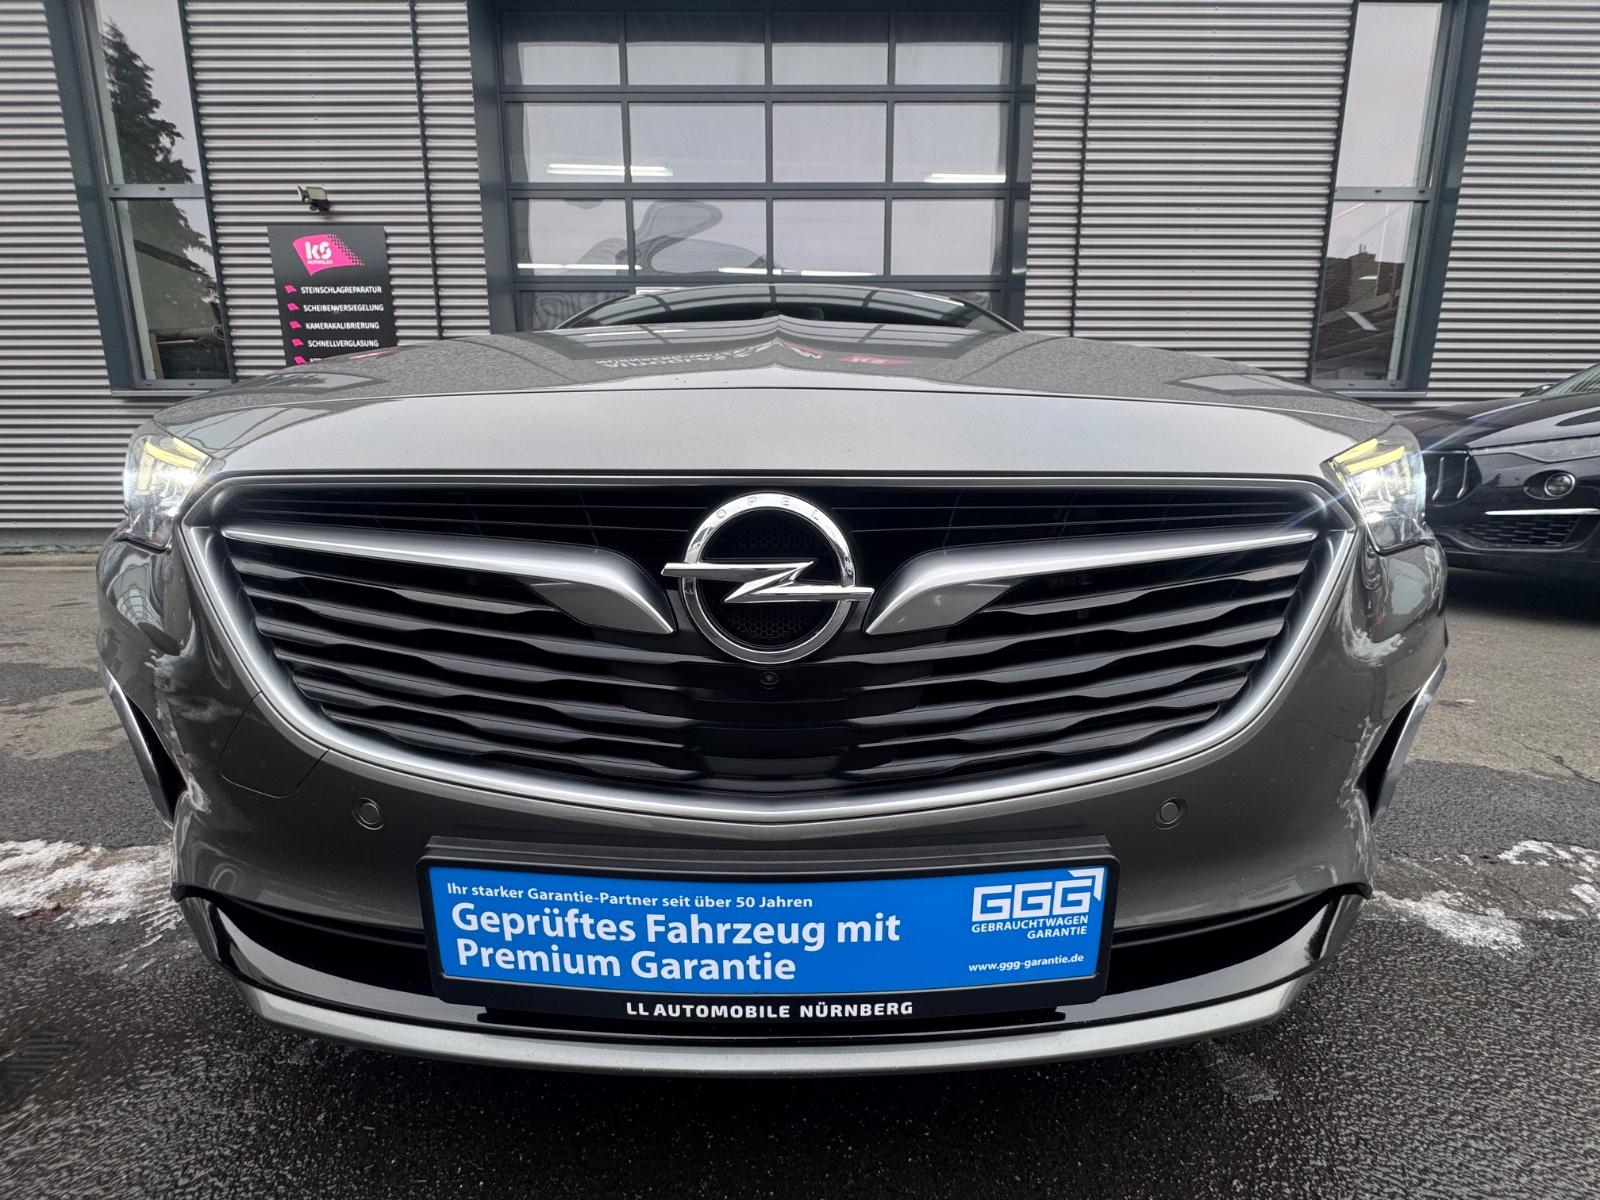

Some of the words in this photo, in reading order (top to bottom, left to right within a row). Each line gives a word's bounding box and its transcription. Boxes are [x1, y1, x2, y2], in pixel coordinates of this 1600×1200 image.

[301, 286, 382, 294] STEINSCHLAGREPARATUR
[303, 304, 384, 312] SCHEIBENVERSIEGELUNG
[305, 322, 379, 330] KAMERAKALIBRIERUNG
[308, 339, 379, 347] SCHNELLVERGLASUNG
[717, 496, 820, 521] OPEL
[447, 883, 468, 894] Ihr
[472, 885, 524, 899] starker
[527, 888, 658, 906] Garantie-Partner
[662, 896, 691, 907] seit
[695, 895, 731, 907] über
[736, 896, 755, 908] 50
[759, 896, 812, 908] Jahren
[971, 879, 1093, 922] GGG
[451, 902, 636, 942] Geprüftes
[646, 913, 825, 951] Fahrzeug
[837, 913, 900, 943] mit
[971, 915, 1089, 933] GEBRAUCHTWAGEN
[1027, 926, 1087, 940] GARANTIE
[456, 938, 620, 976] Premium
[631, 949, 796, 980] Garantie
[968, 954, 1084, 972] www.ggg-garantie.de
[626, 1002, 649, 1016] LL
[653, 1003, 790, 1018] AUTOMOBILE
[800, 1001, 913, 1017] NÜRNBERG
